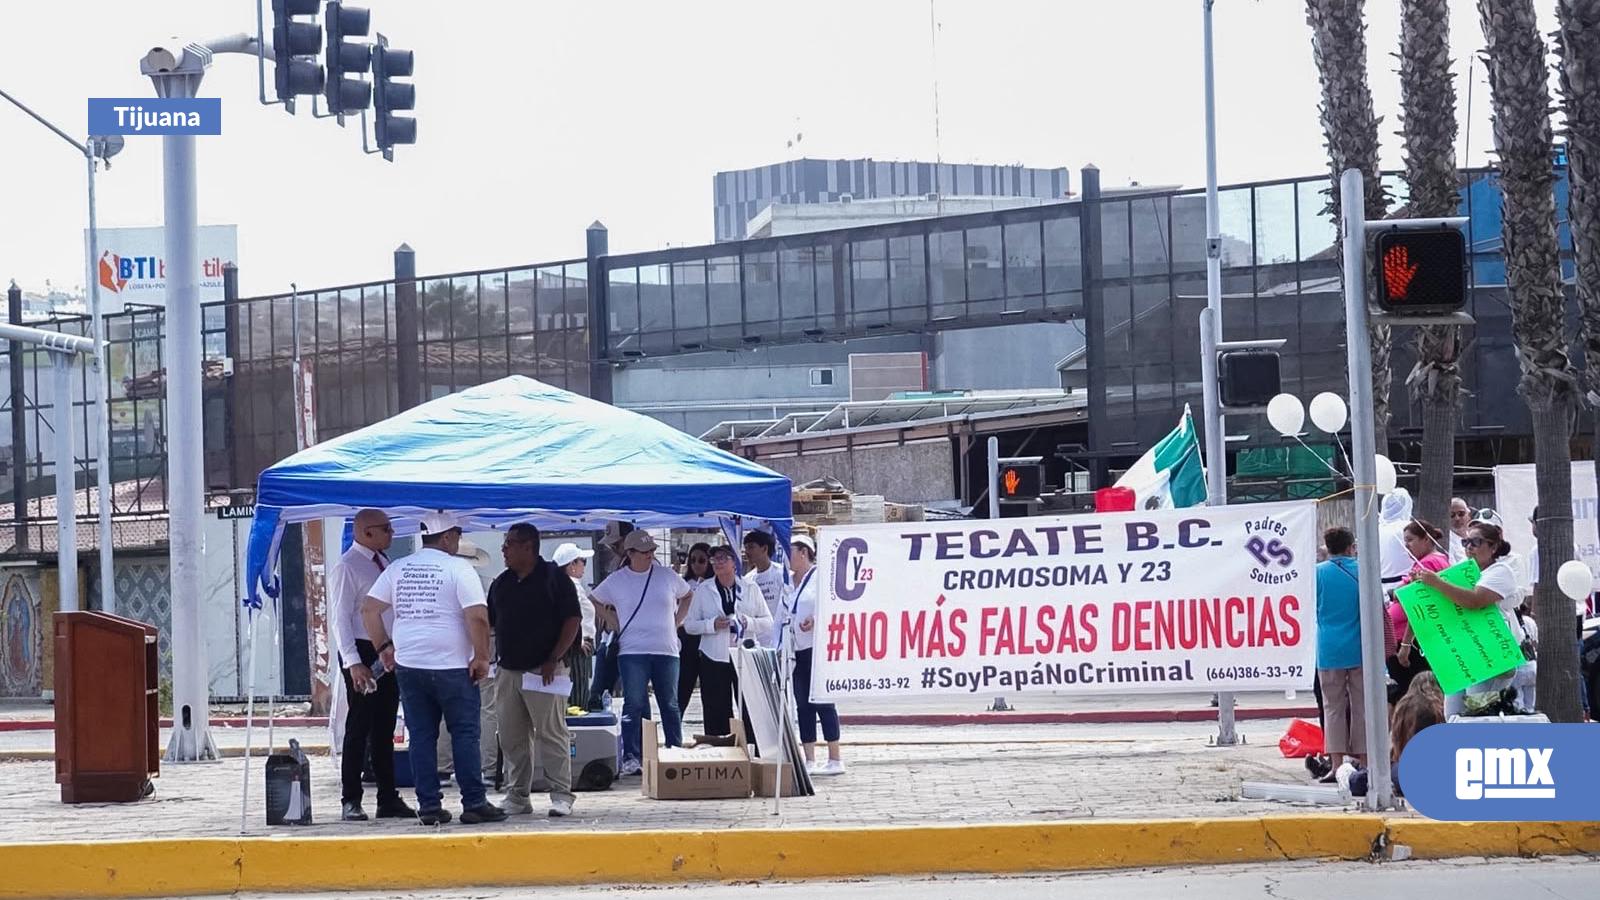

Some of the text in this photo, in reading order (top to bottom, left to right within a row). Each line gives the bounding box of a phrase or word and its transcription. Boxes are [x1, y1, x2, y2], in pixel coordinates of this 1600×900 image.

[900, 518, 1223, 561] TECATE B.C.
[1244, 516, 1288, 537] Padres
[1244, 534, 1295, 568] PS
[943, 560, 1172, 591] CROMOSOMA Y 23
[1249, 567, 1299, 585] Solteros
[826, 593, 1301, 662] #NO MÁS FALSAS DENUNCIAS
[825, 677, 910, 693] (664)386-33-92
[920, 660, 1194, 693] #SoyPapáNoCriminal
[1206, 665, 1303, 681] (664)386-33-92
